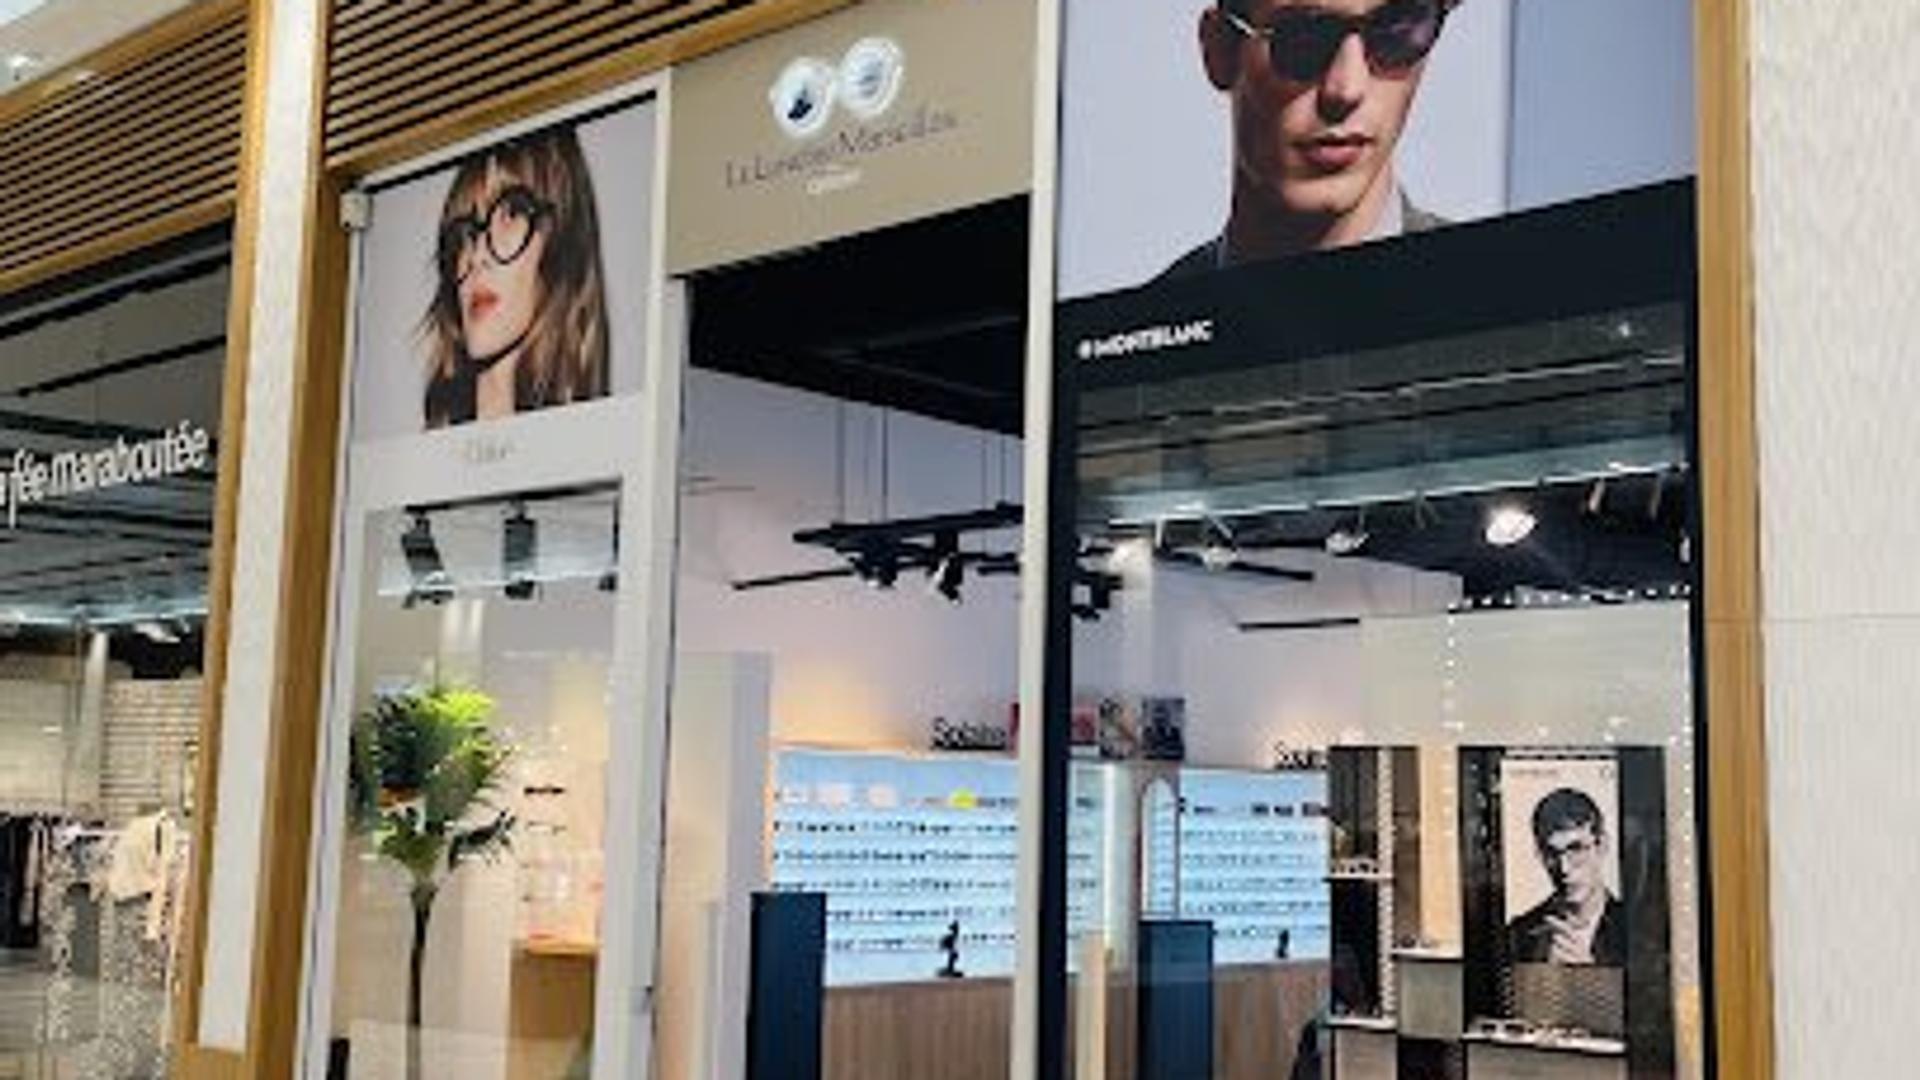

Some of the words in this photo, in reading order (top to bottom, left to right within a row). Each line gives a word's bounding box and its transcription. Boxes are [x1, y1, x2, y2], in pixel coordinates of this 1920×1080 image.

[1093, 320, 1214, 358] MONTBLANC
[9, 448, 48, 529] fée
[50, 419, 210, 495] maraboutée
